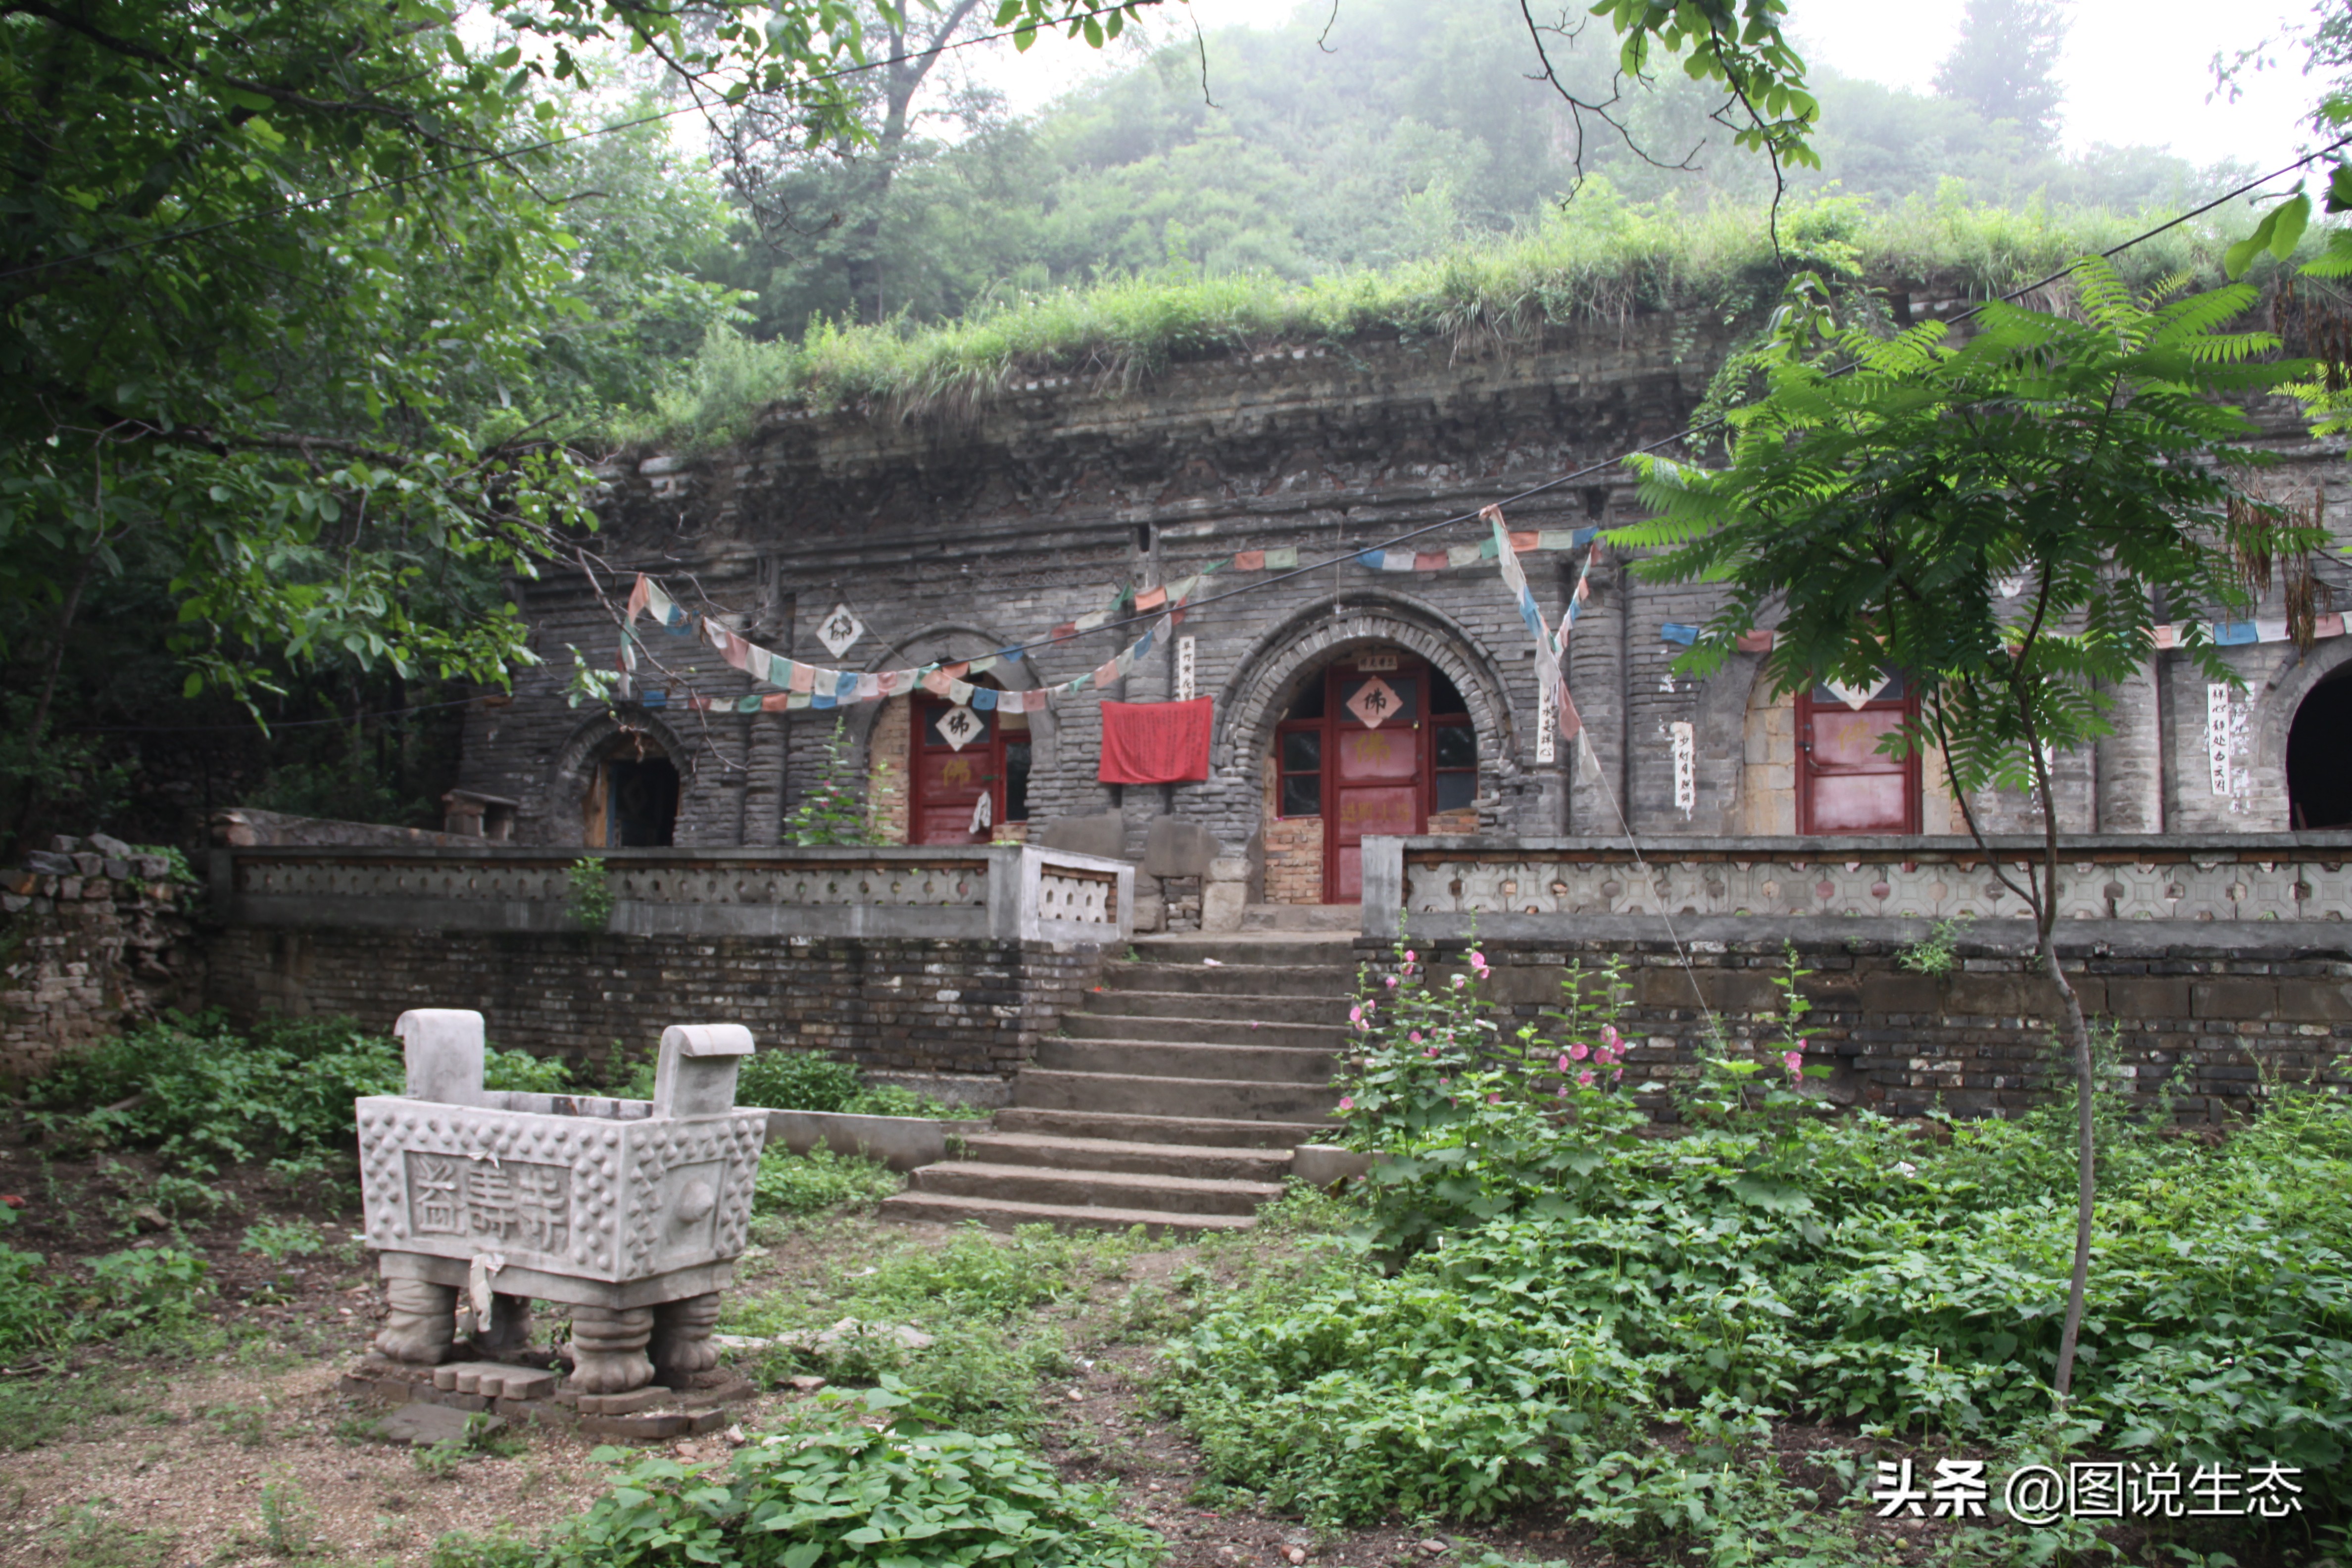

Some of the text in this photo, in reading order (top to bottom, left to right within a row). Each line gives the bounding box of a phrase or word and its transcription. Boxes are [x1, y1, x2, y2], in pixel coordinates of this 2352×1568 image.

[1364, 687, 1387, 715] 佛
[947, 710, 970, 738] 佛
[1352, 731, 1391, 769] 佛
[940, 757, 971, 791] 佛
